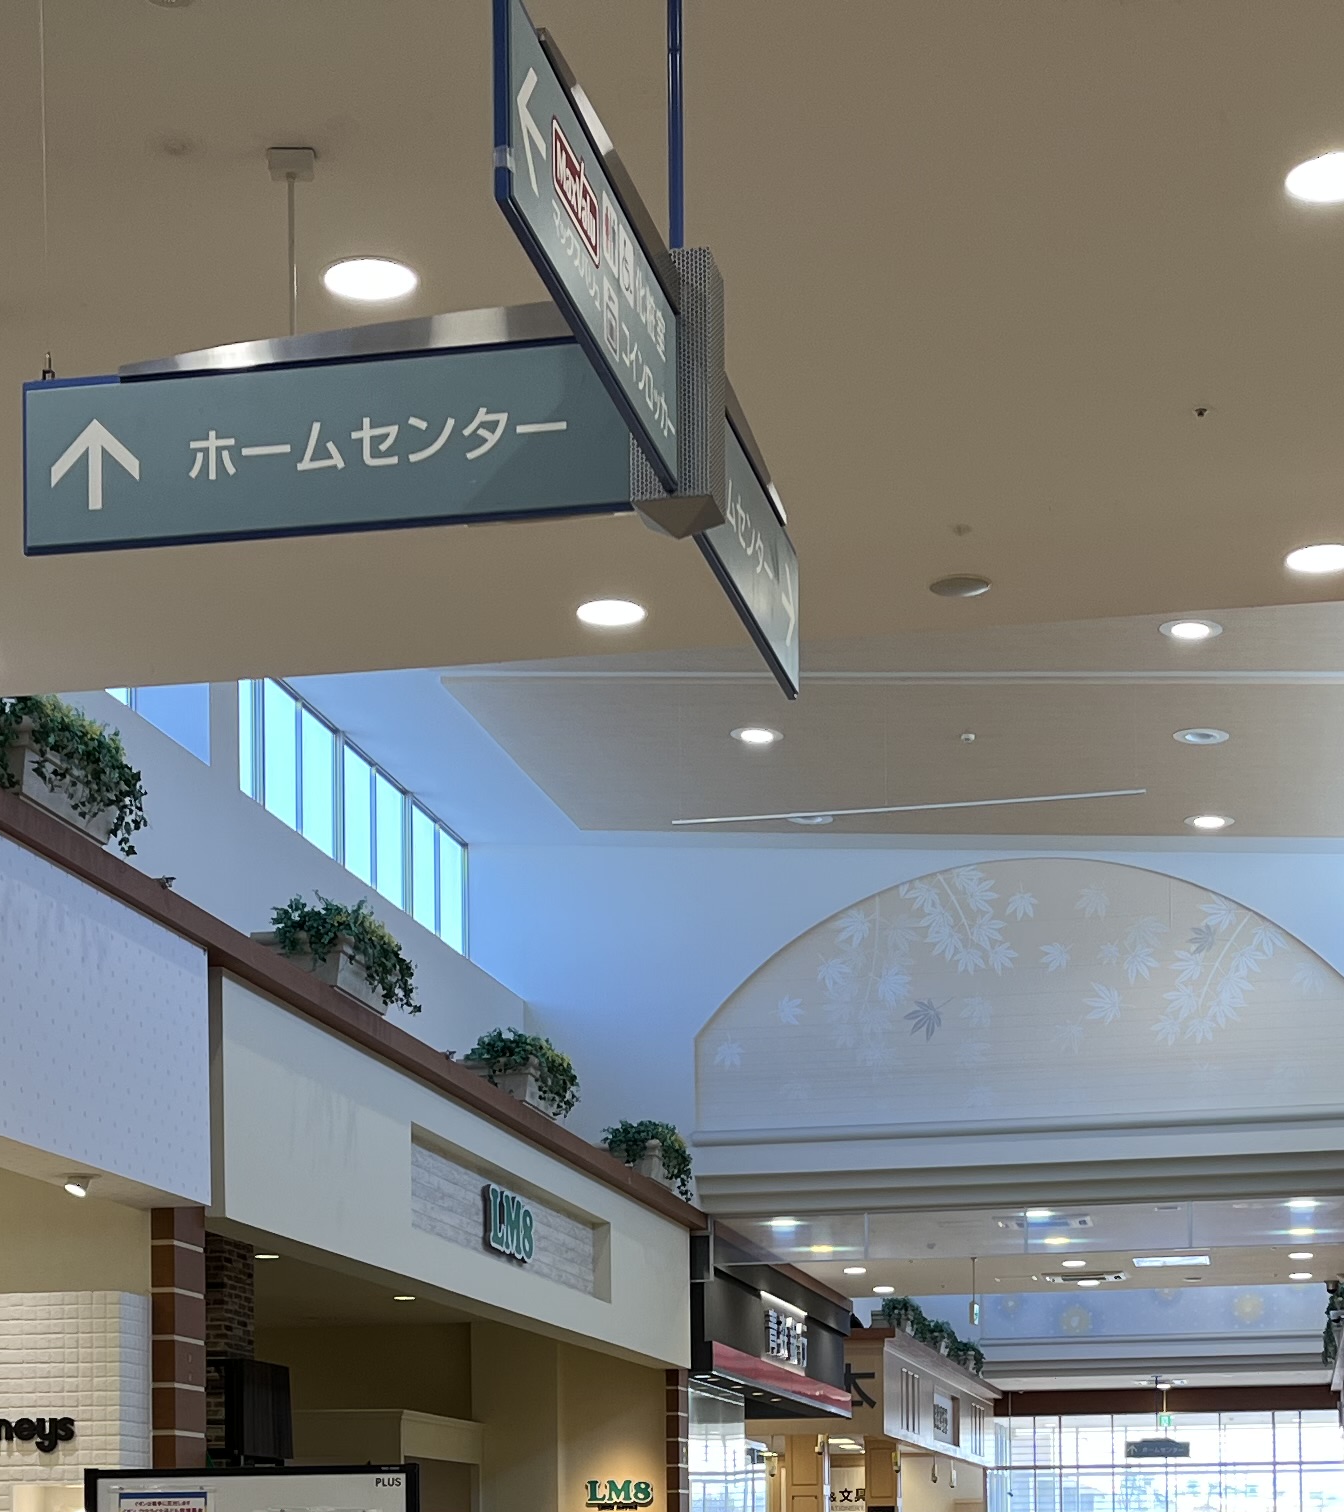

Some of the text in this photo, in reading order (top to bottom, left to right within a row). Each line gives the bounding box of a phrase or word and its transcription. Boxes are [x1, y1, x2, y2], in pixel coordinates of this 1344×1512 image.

[634, 269, 666, 363] 化粧室
[621, 320, 676, 440] コインロッカー
[188, 406, 568, 481] ホームセンター
[489, 1184, 534, 1264] LM8
[374, 1477, 402, 1488] PLUS
[585, 1479, 652, 1503] LM8
